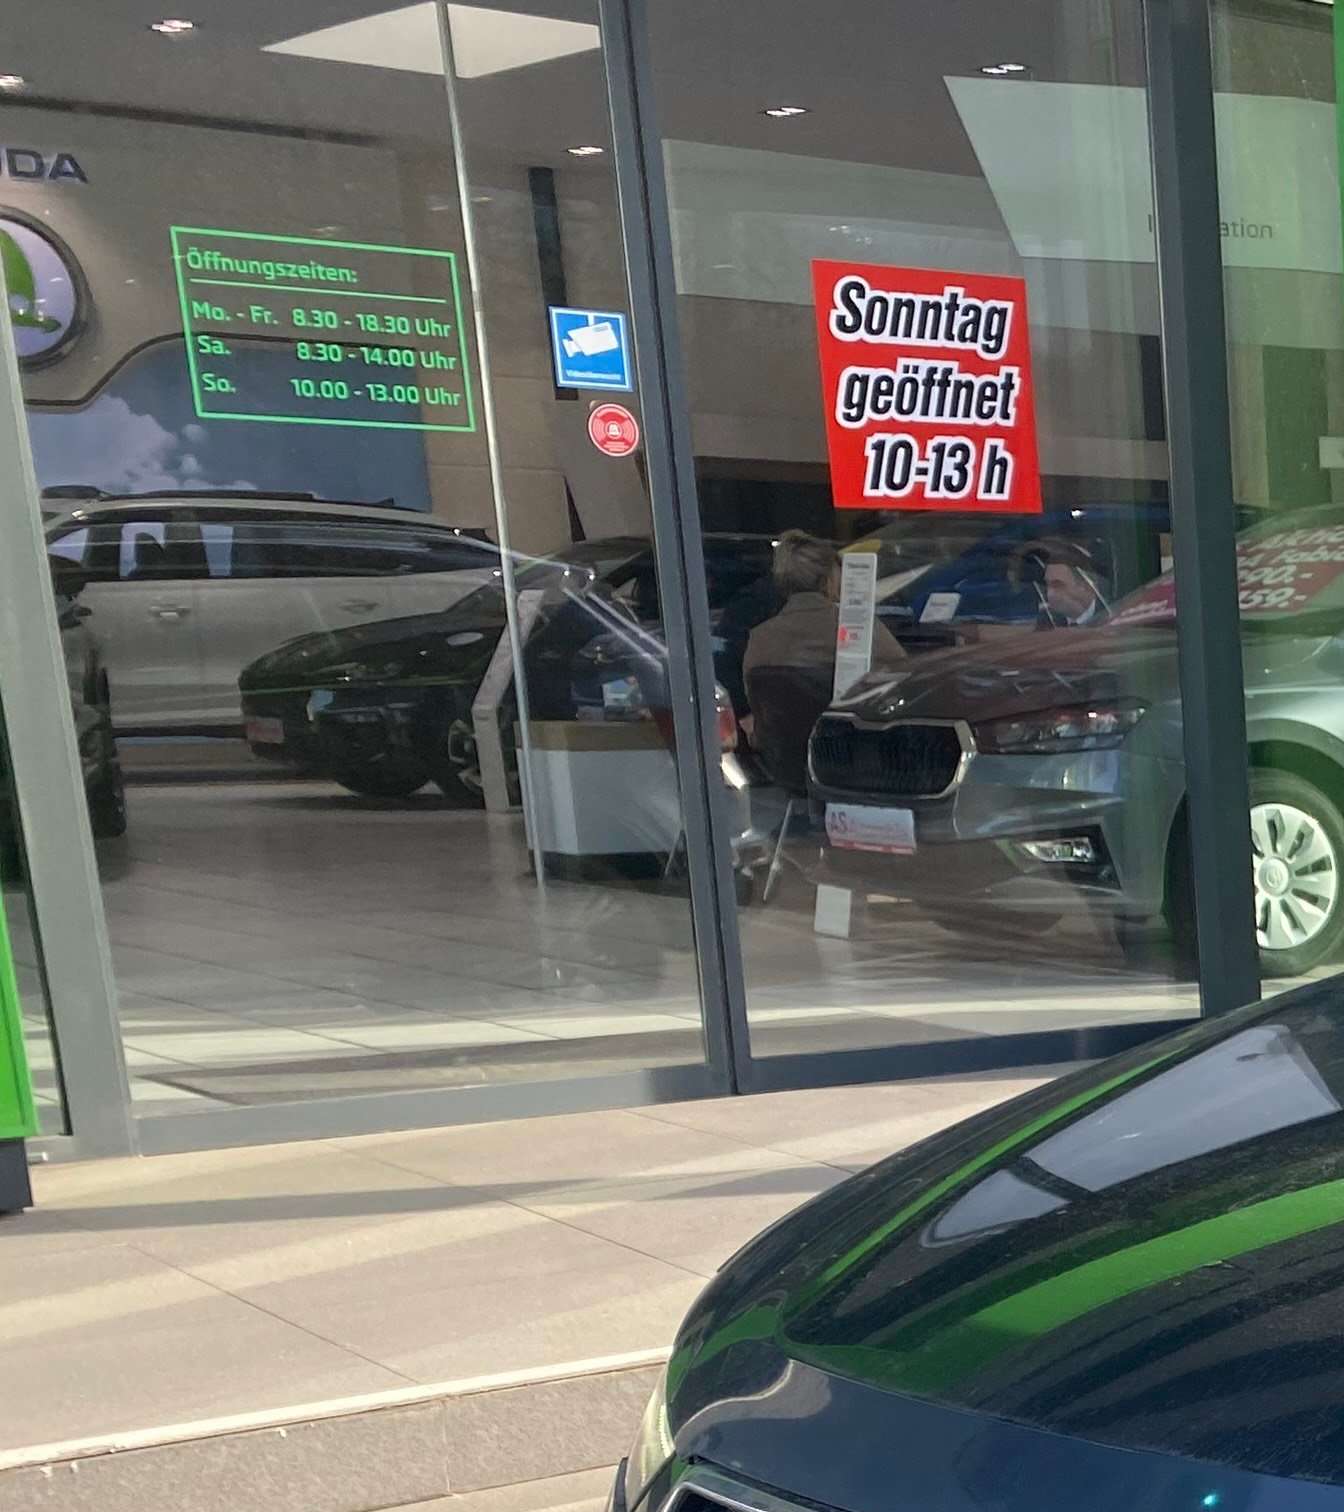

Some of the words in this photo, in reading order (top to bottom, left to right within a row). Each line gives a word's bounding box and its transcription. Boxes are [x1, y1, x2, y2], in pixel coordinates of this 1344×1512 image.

[186, 247, 358, 283] Öffnungszeiten:
[192, 301, 232, 321] Mo.
[250, 305, 279, 324] Fr.
[292, 308, 338, 329] 8.30
[356, 313, 411, 335] 18.30
[415, 318, 451, 337] Uhr
[836, 280, 1009, 355] Sonntag
[198, 335, 232, 355] Sa.
[296, 342, 343, 362] 8.30
[360, 346, 416, 367] 14.00
[420, 351, 457, 370] Uhr
[202, 373, 236, 393] So.
[290, 379, 348, 400] 10.00
[366, 384, 420, 404] 13.00
[425, 387, 461, 405] Uhr
[843, 364, 1016, 423] geöffnet
[870, 439, 971, 493] 10-13
[983, 445, 1009, 495] h
